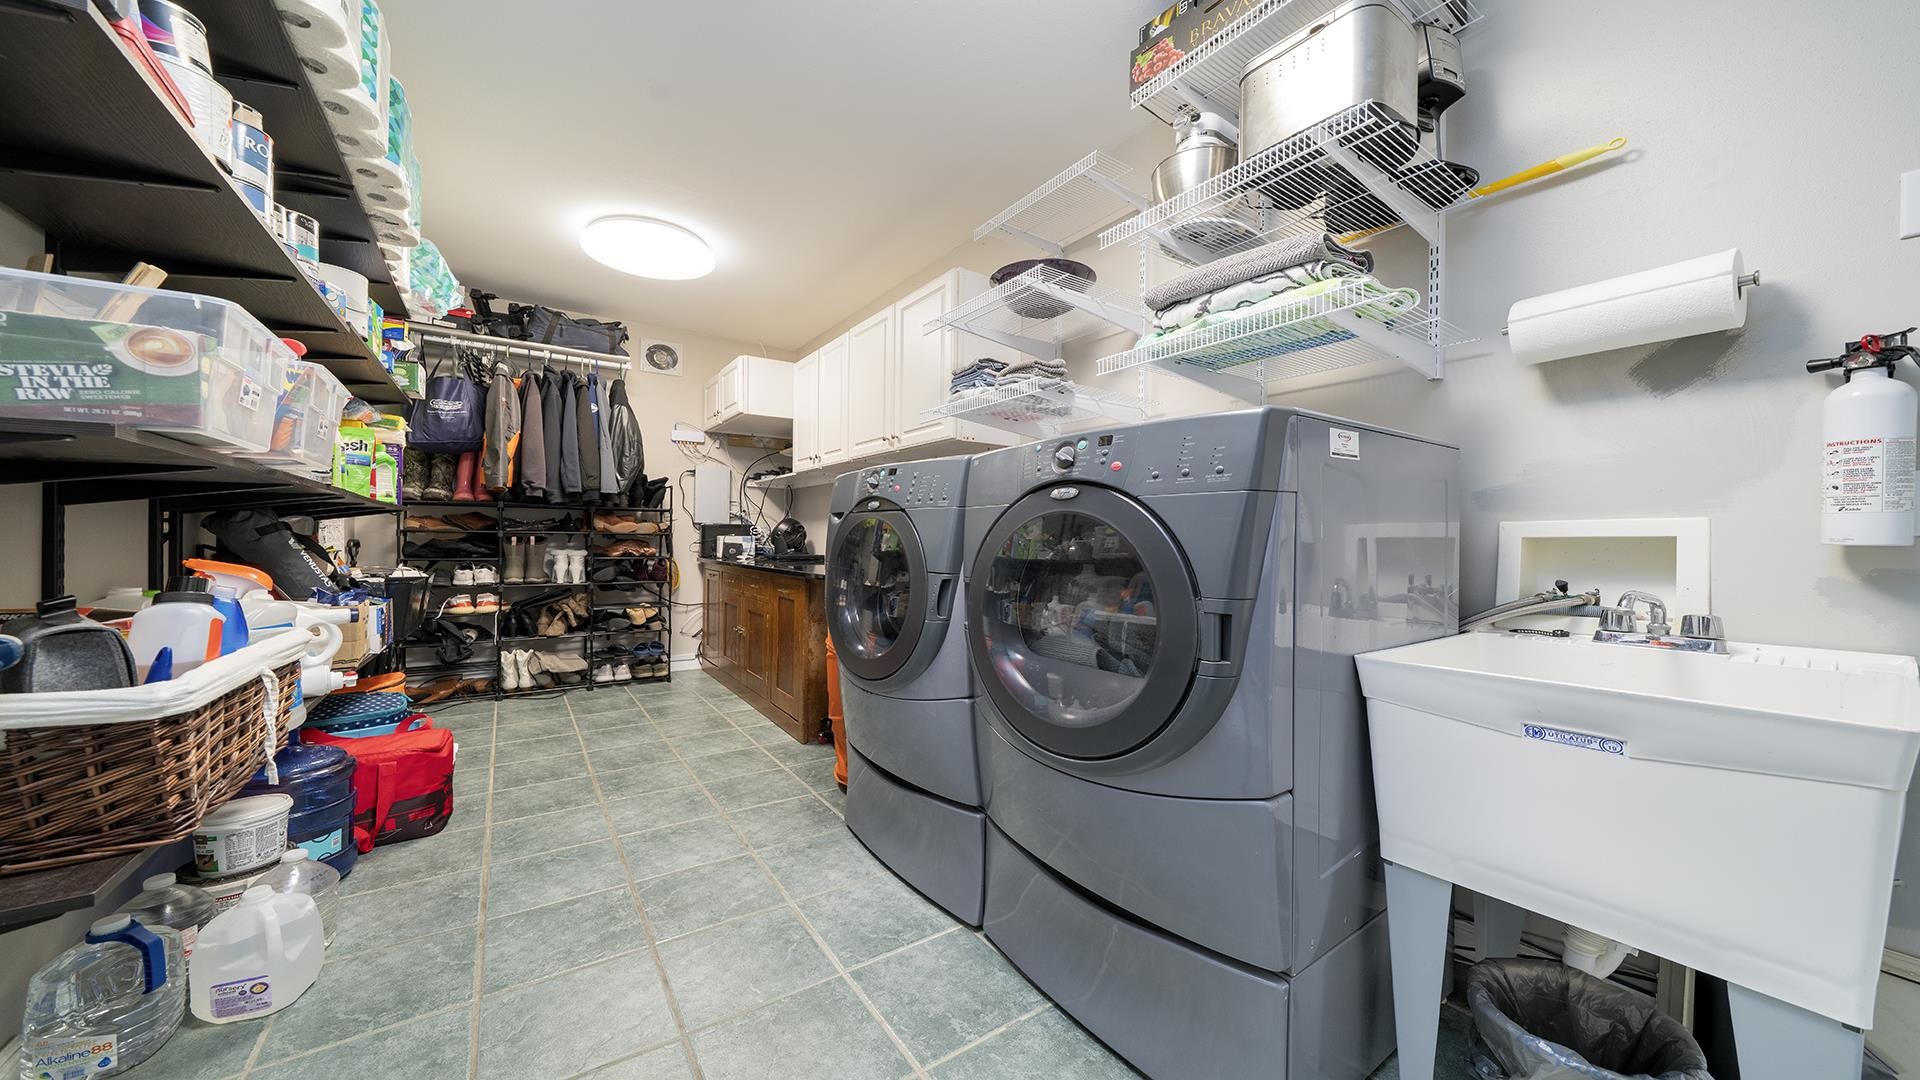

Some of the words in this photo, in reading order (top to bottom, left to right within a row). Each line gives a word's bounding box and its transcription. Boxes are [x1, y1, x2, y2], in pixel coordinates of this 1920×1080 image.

[0, 363, 95, 376] STEVIA
[20, 376, 50, 388] IN
[53, 376, 111, 388] THE
[14, 387, 73, 400] RAW
[1826, 438, 1882, 447] INSTRUCTIONS
[300, 549, 333, 588] VENUSTAS
